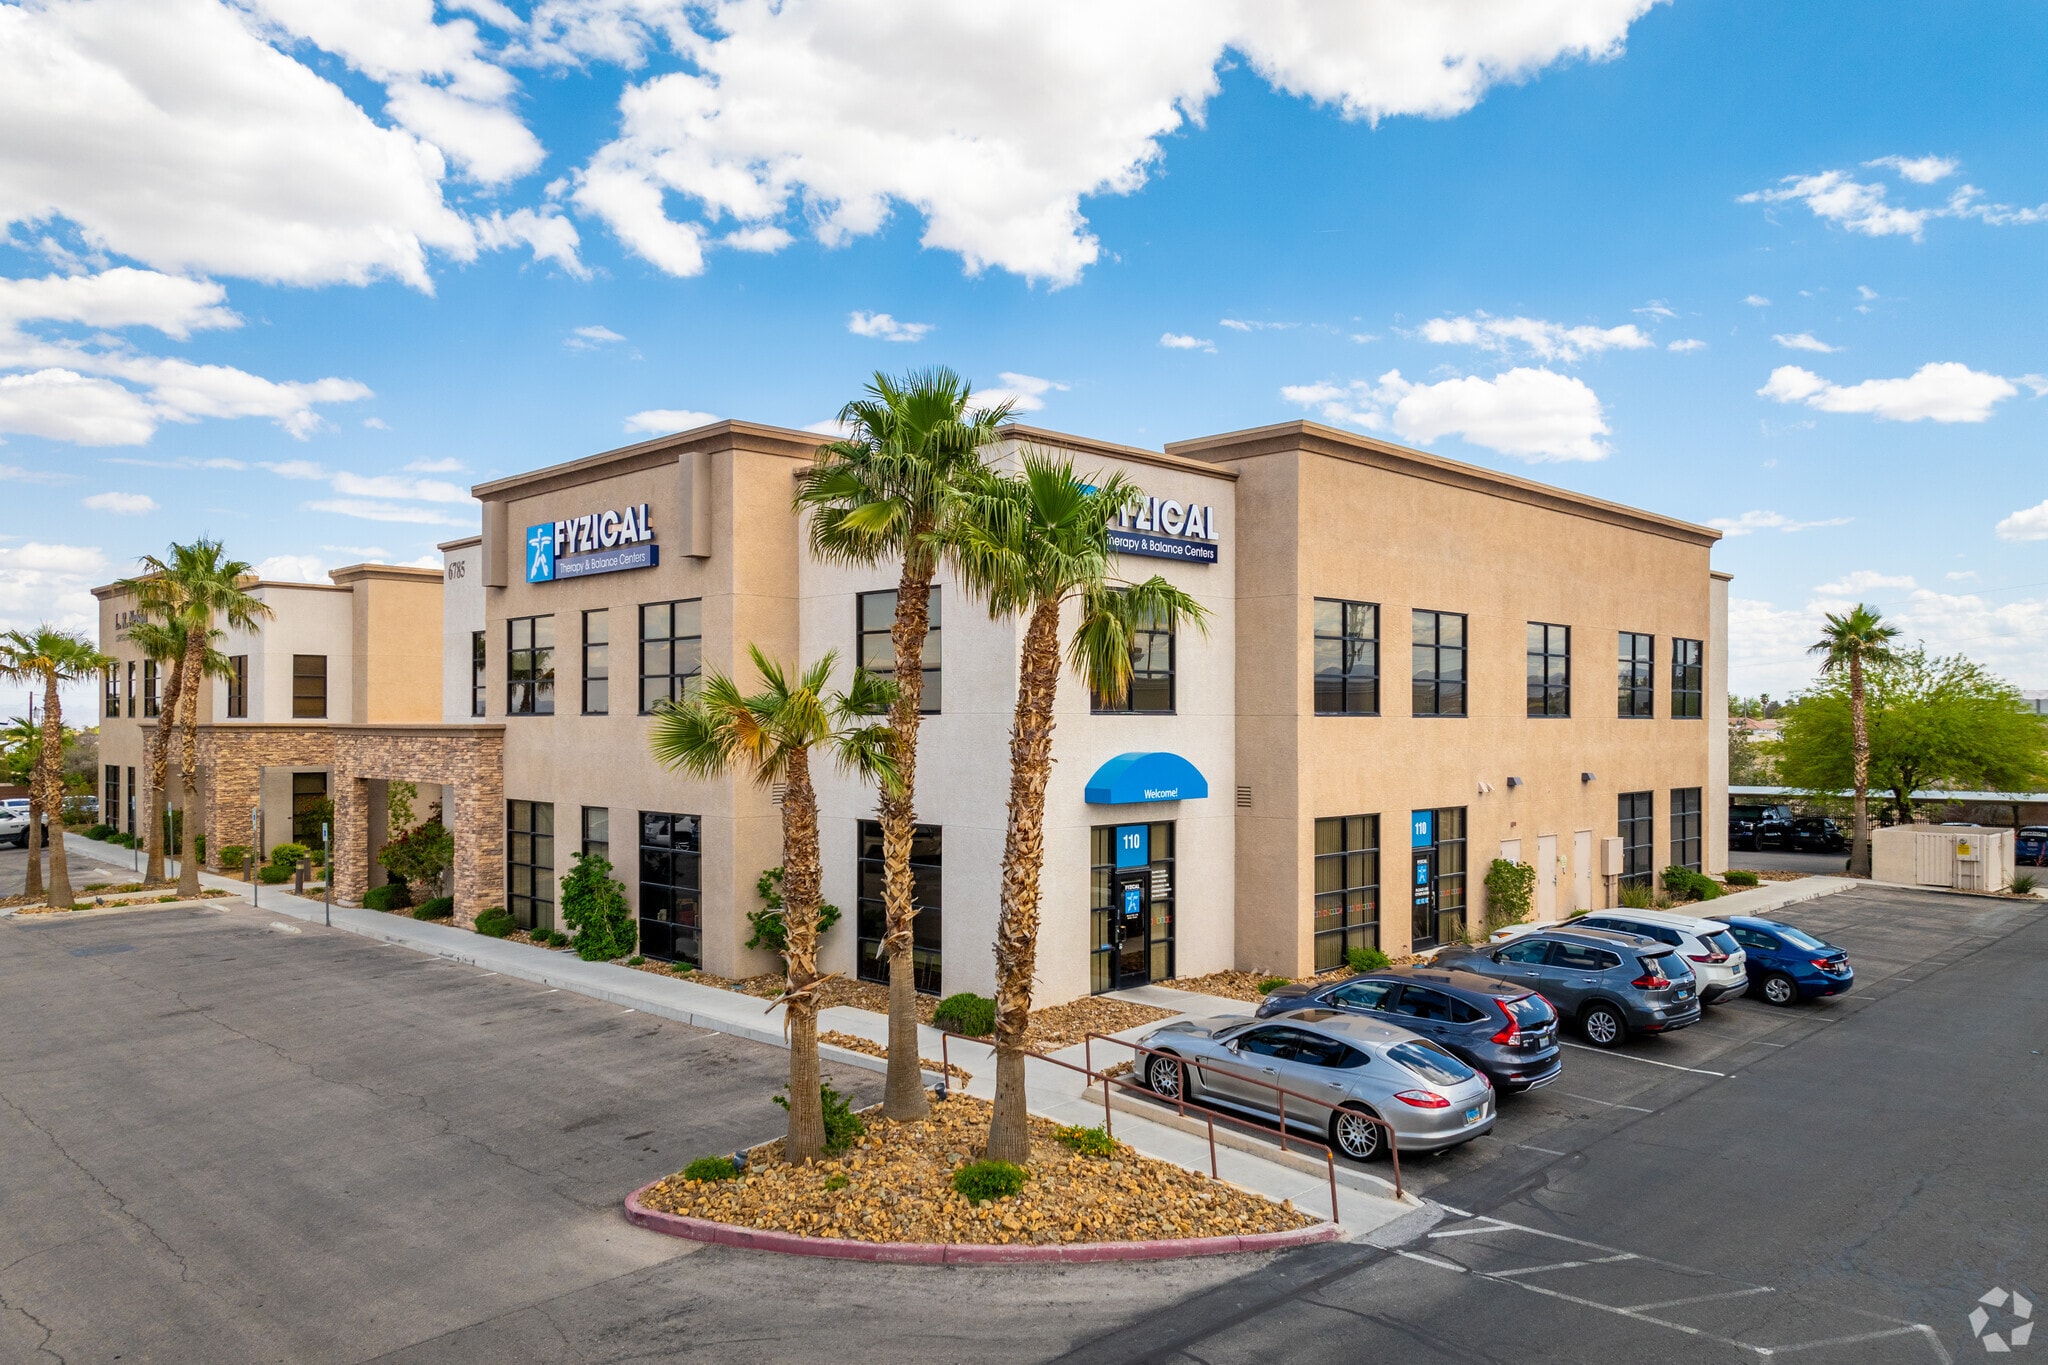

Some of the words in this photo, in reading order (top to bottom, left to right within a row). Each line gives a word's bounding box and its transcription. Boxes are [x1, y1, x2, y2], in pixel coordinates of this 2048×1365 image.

[1119, 495, 1219, 540] YZICAL
[554, 503, 652, 556] FYZICAL
[1141, 538, 1148, 550] &
[1149, 540, 1183, 554] Balance
[1184, 545, 1214, 559] Centers
[448, 560, 466, 580] 6785
[560, 562, 585, 574] Therapy
[585, 561, 590, 570] &
[591, 556, 618, 569] Balance
[619, 552, 646, 565] Centers
[1144, 788, 1178, 799] Welcome!
[1414, 821, 1427, 835] 110
[1123, 833, 1140, 849] 110
